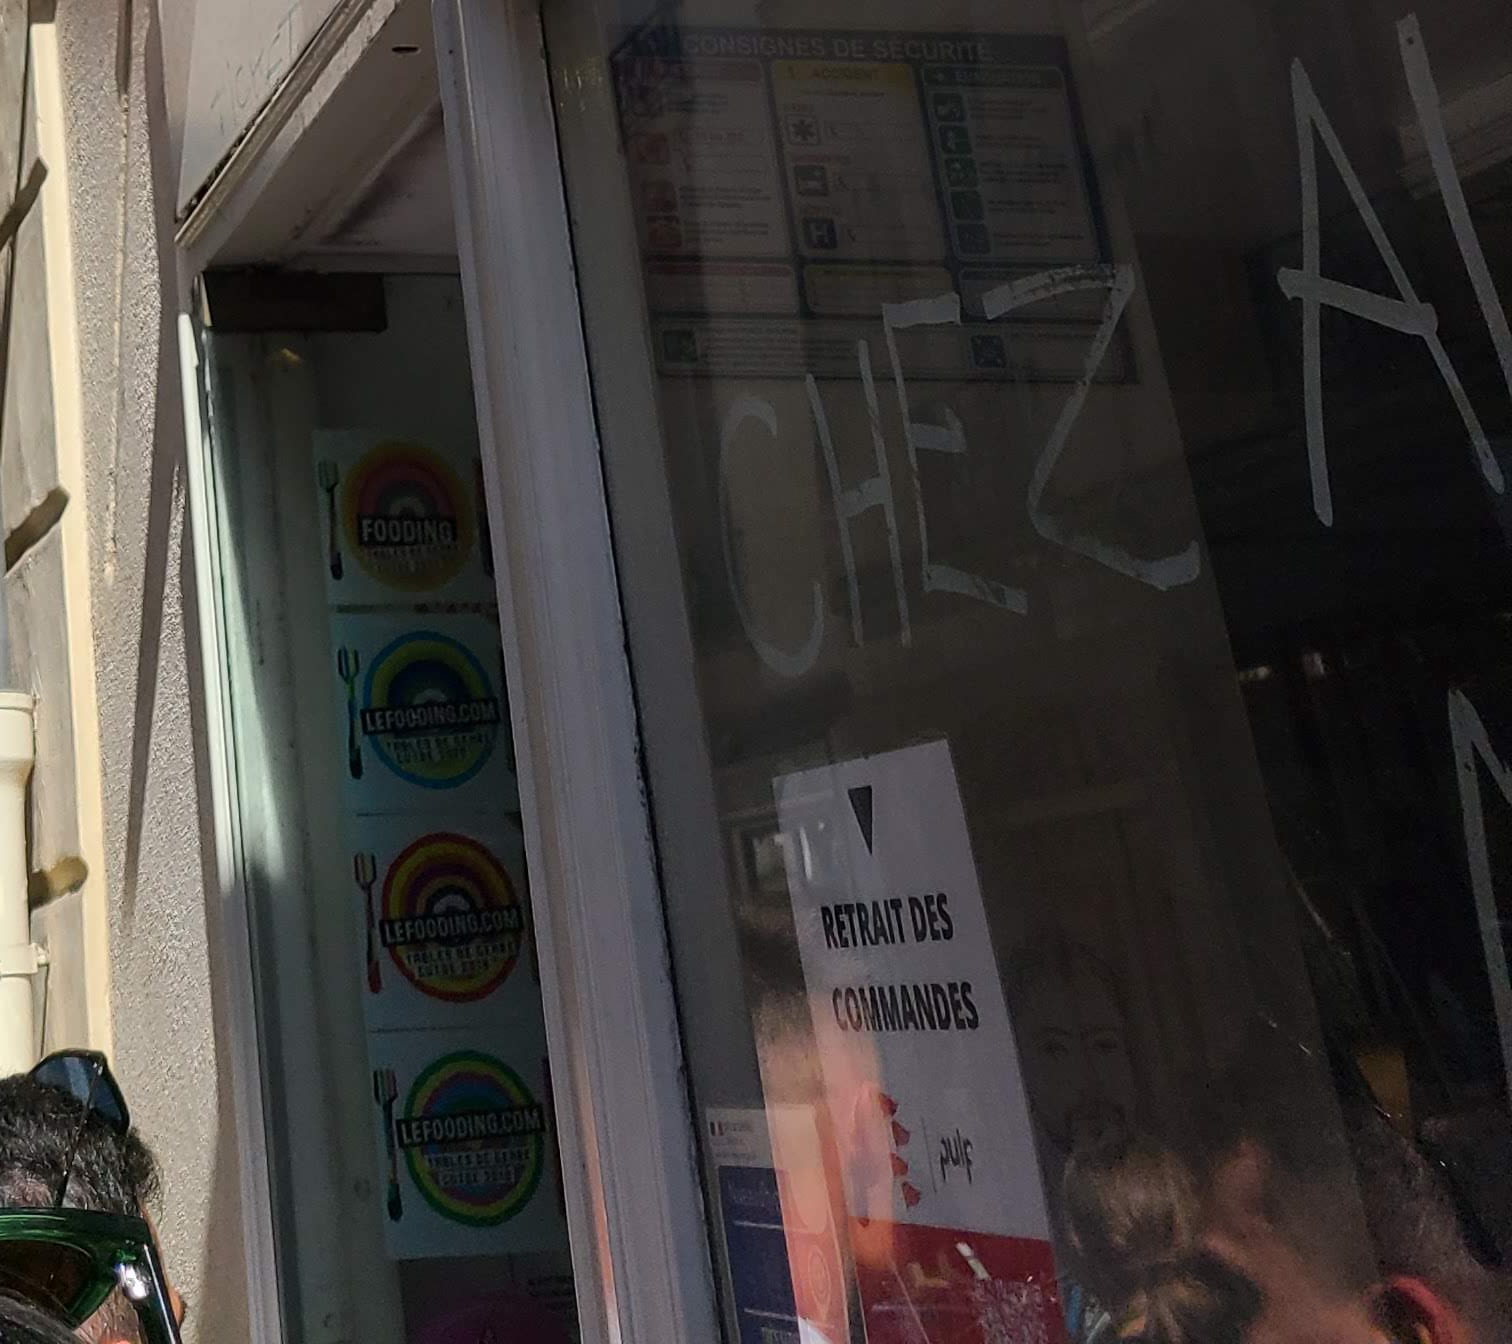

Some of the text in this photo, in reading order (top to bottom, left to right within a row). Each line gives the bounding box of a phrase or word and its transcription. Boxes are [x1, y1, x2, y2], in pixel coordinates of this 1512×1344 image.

[834, 39, 865, 59] DE
[720, 264, 1202, 677] CHEZ
[362, 520, 453, 543] FOODING
[384, 909, 519, 943] LEFOODING.COM
[821, 893, 953, 950] RETRAIT DES
[832, 981, 978, 1032] COMMANDES
[401, 1109, 542, 1144] LEFOODING.COM
